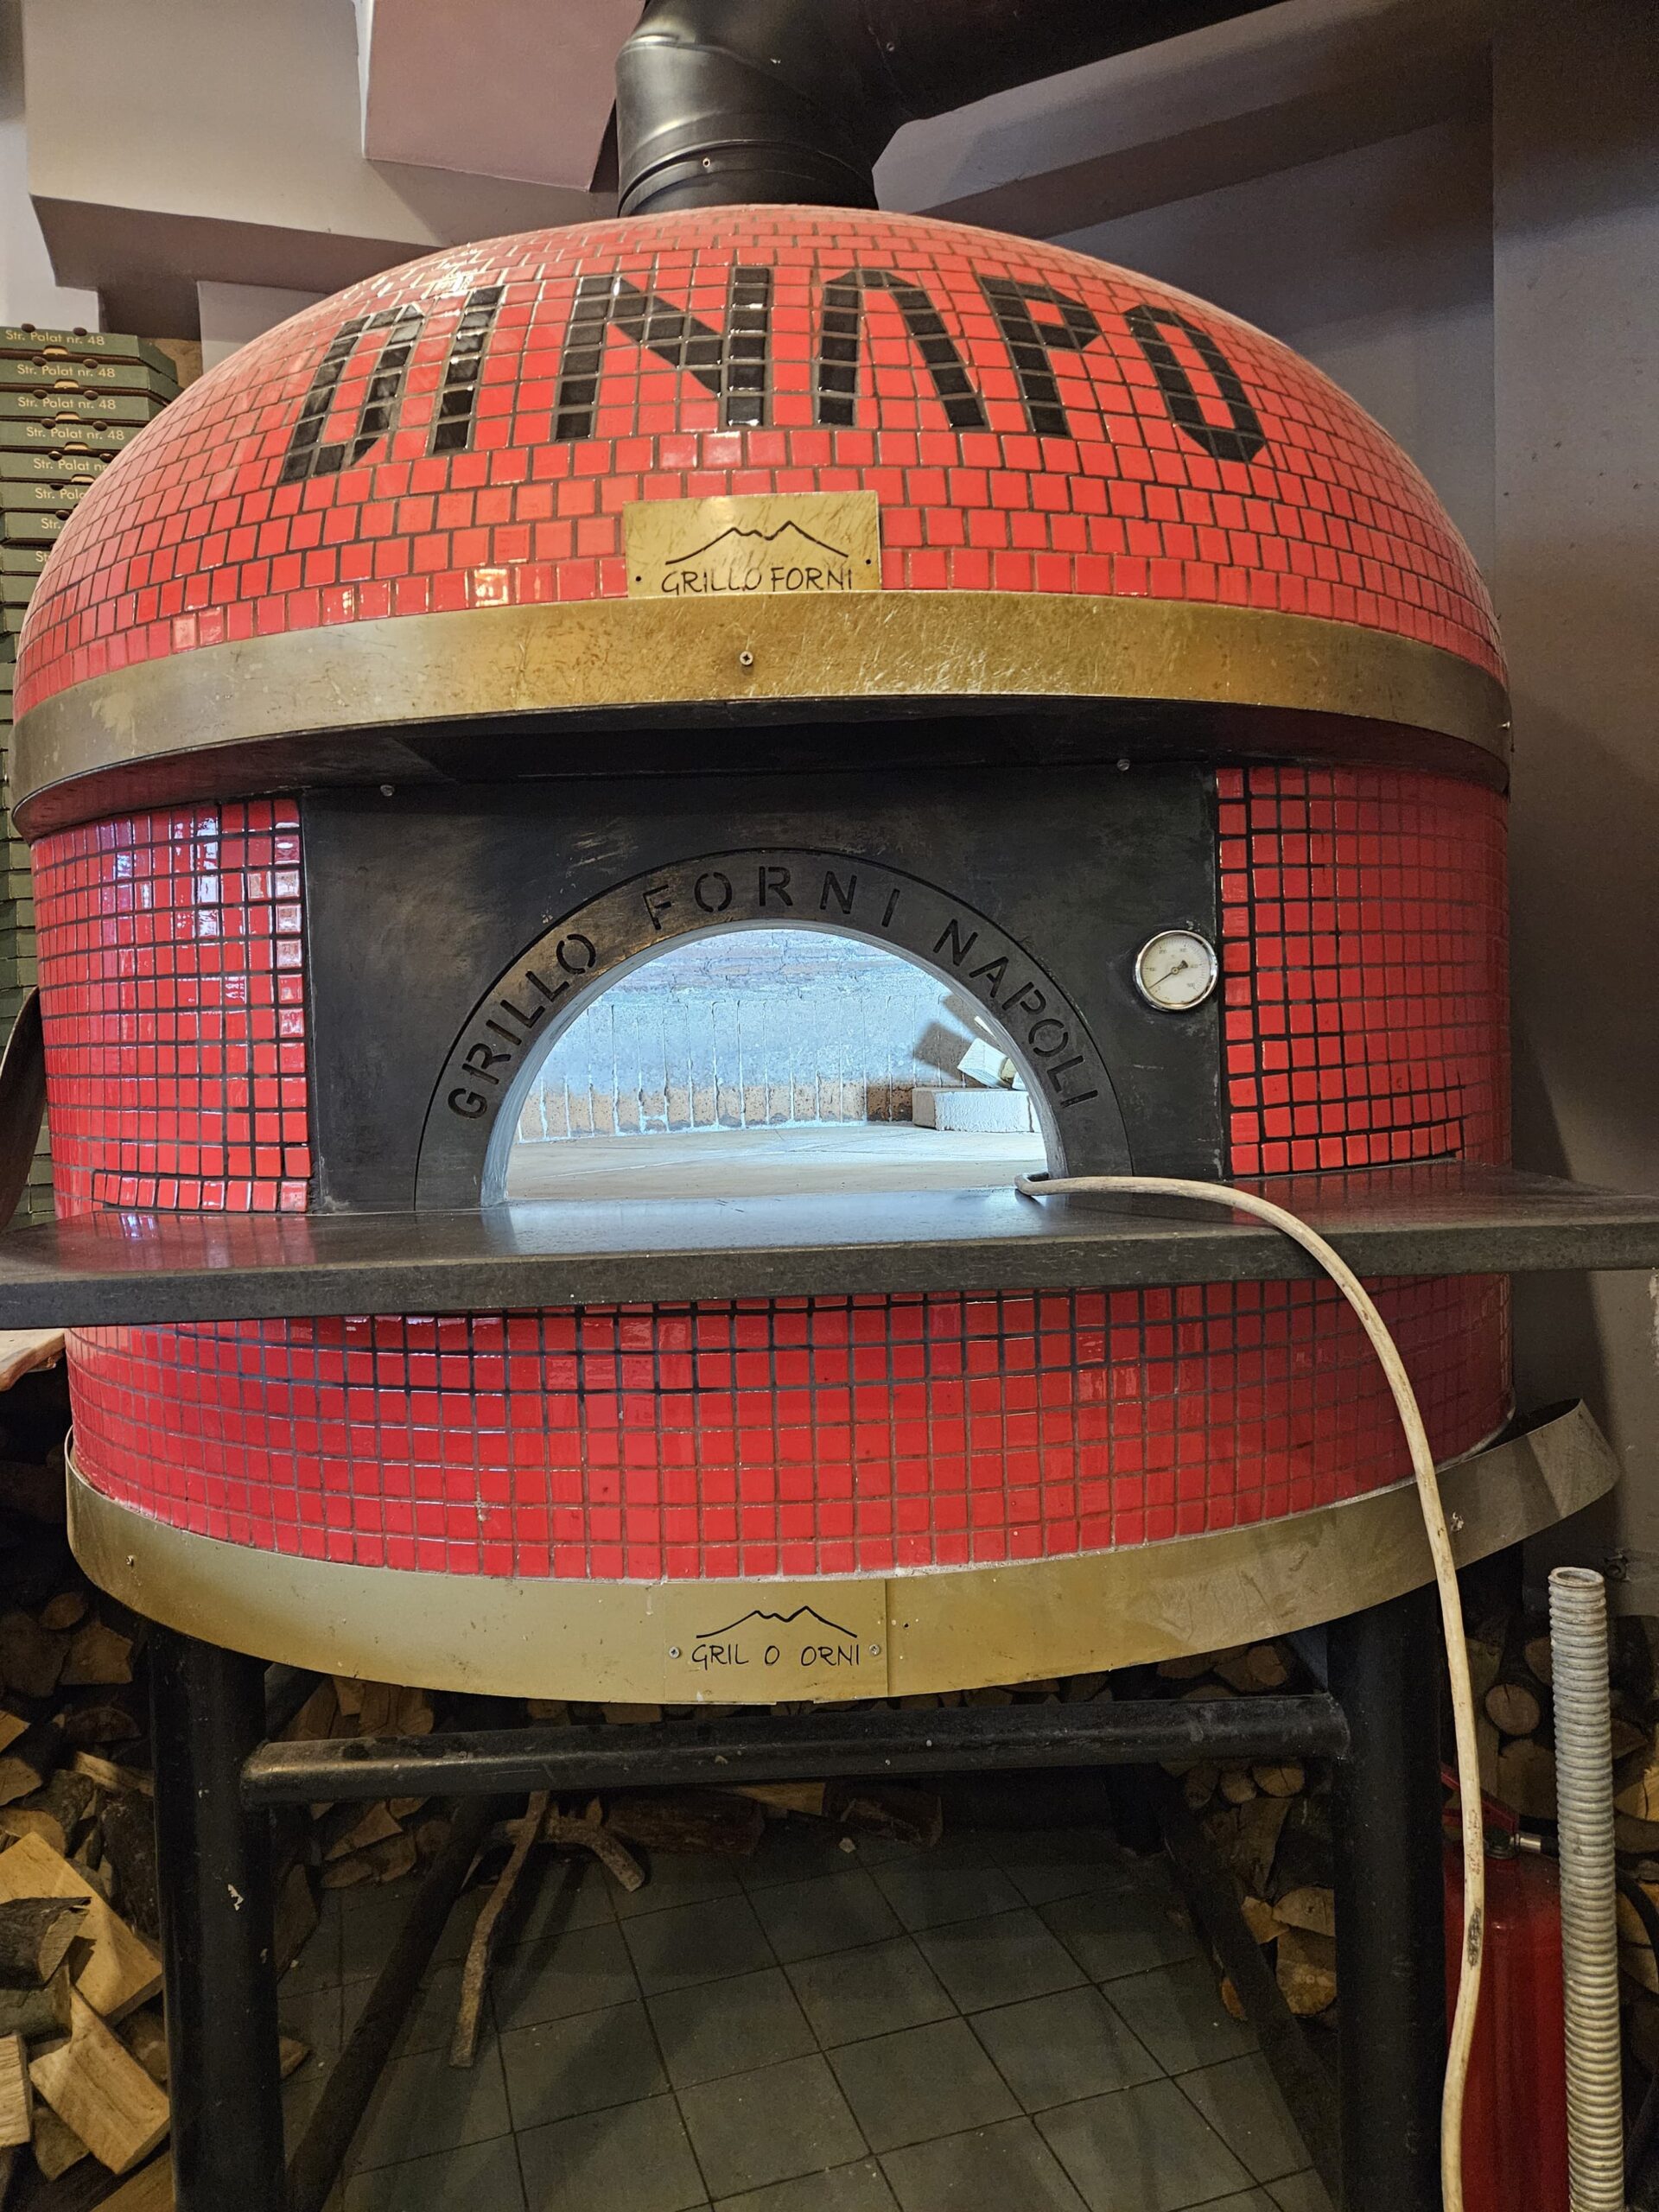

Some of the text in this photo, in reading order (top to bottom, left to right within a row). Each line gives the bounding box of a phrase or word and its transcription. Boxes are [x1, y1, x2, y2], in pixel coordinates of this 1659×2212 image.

[5, 329, 105, 346] Str. Palat nr. 48
[17, 364, 116, 378] Str. Palat nr. 48
[17, 397, 116, 410] Str. Palat nr. 48
[26, 426, 124, 441] Str. Palat nr. 48
[33, 458, 54, 470] Str.
[58, 459, 89, 471] Palat
[35, 487, 86, 500] Str. Pala
[41, 518, 61, 530] Str.
[661, 567, 853, 596] GRILLO FORNI
[447, 865, 1099, 1119] GRILLO FORNI NAPOLI
